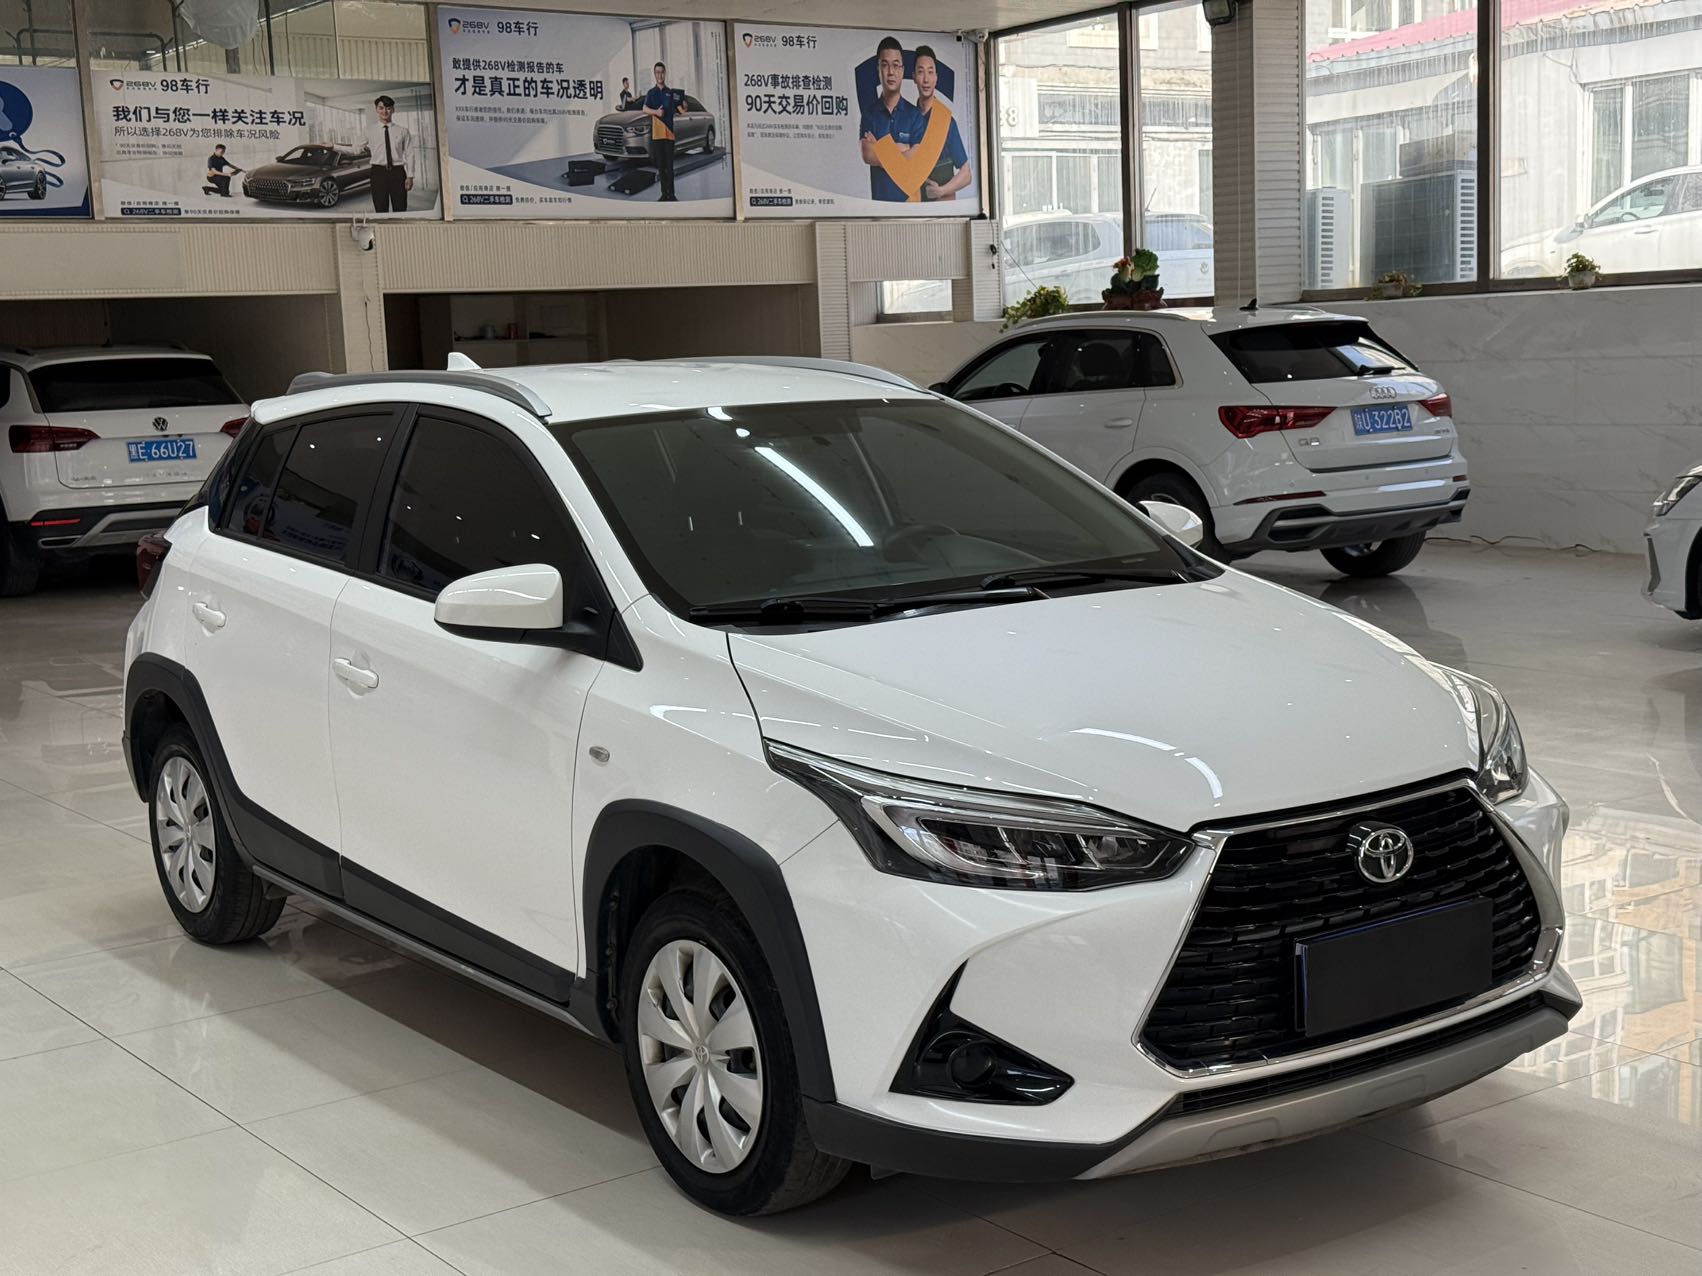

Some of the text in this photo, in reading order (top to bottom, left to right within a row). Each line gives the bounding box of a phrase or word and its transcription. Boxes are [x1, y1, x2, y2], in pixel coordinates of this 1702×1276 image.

[462, 20, 539, 36] 268V 98车行
[781, 35, 817, 49] 98车行
[452, 57, 564, 75] 敢提供268V检测报告的车
[160, 78, 210, 94] 98车行
[454, 74, 604, 101] 才是真正的车况透明
[744, 73, 833, 91] 268V事故排查检测
[745, 93, 849, 116] 90天交易价回购
[112, 105, 306, 127] 我们与您一样关注车况
[114, 126, 281, 140] 所以选择268V为您排除车况风险
